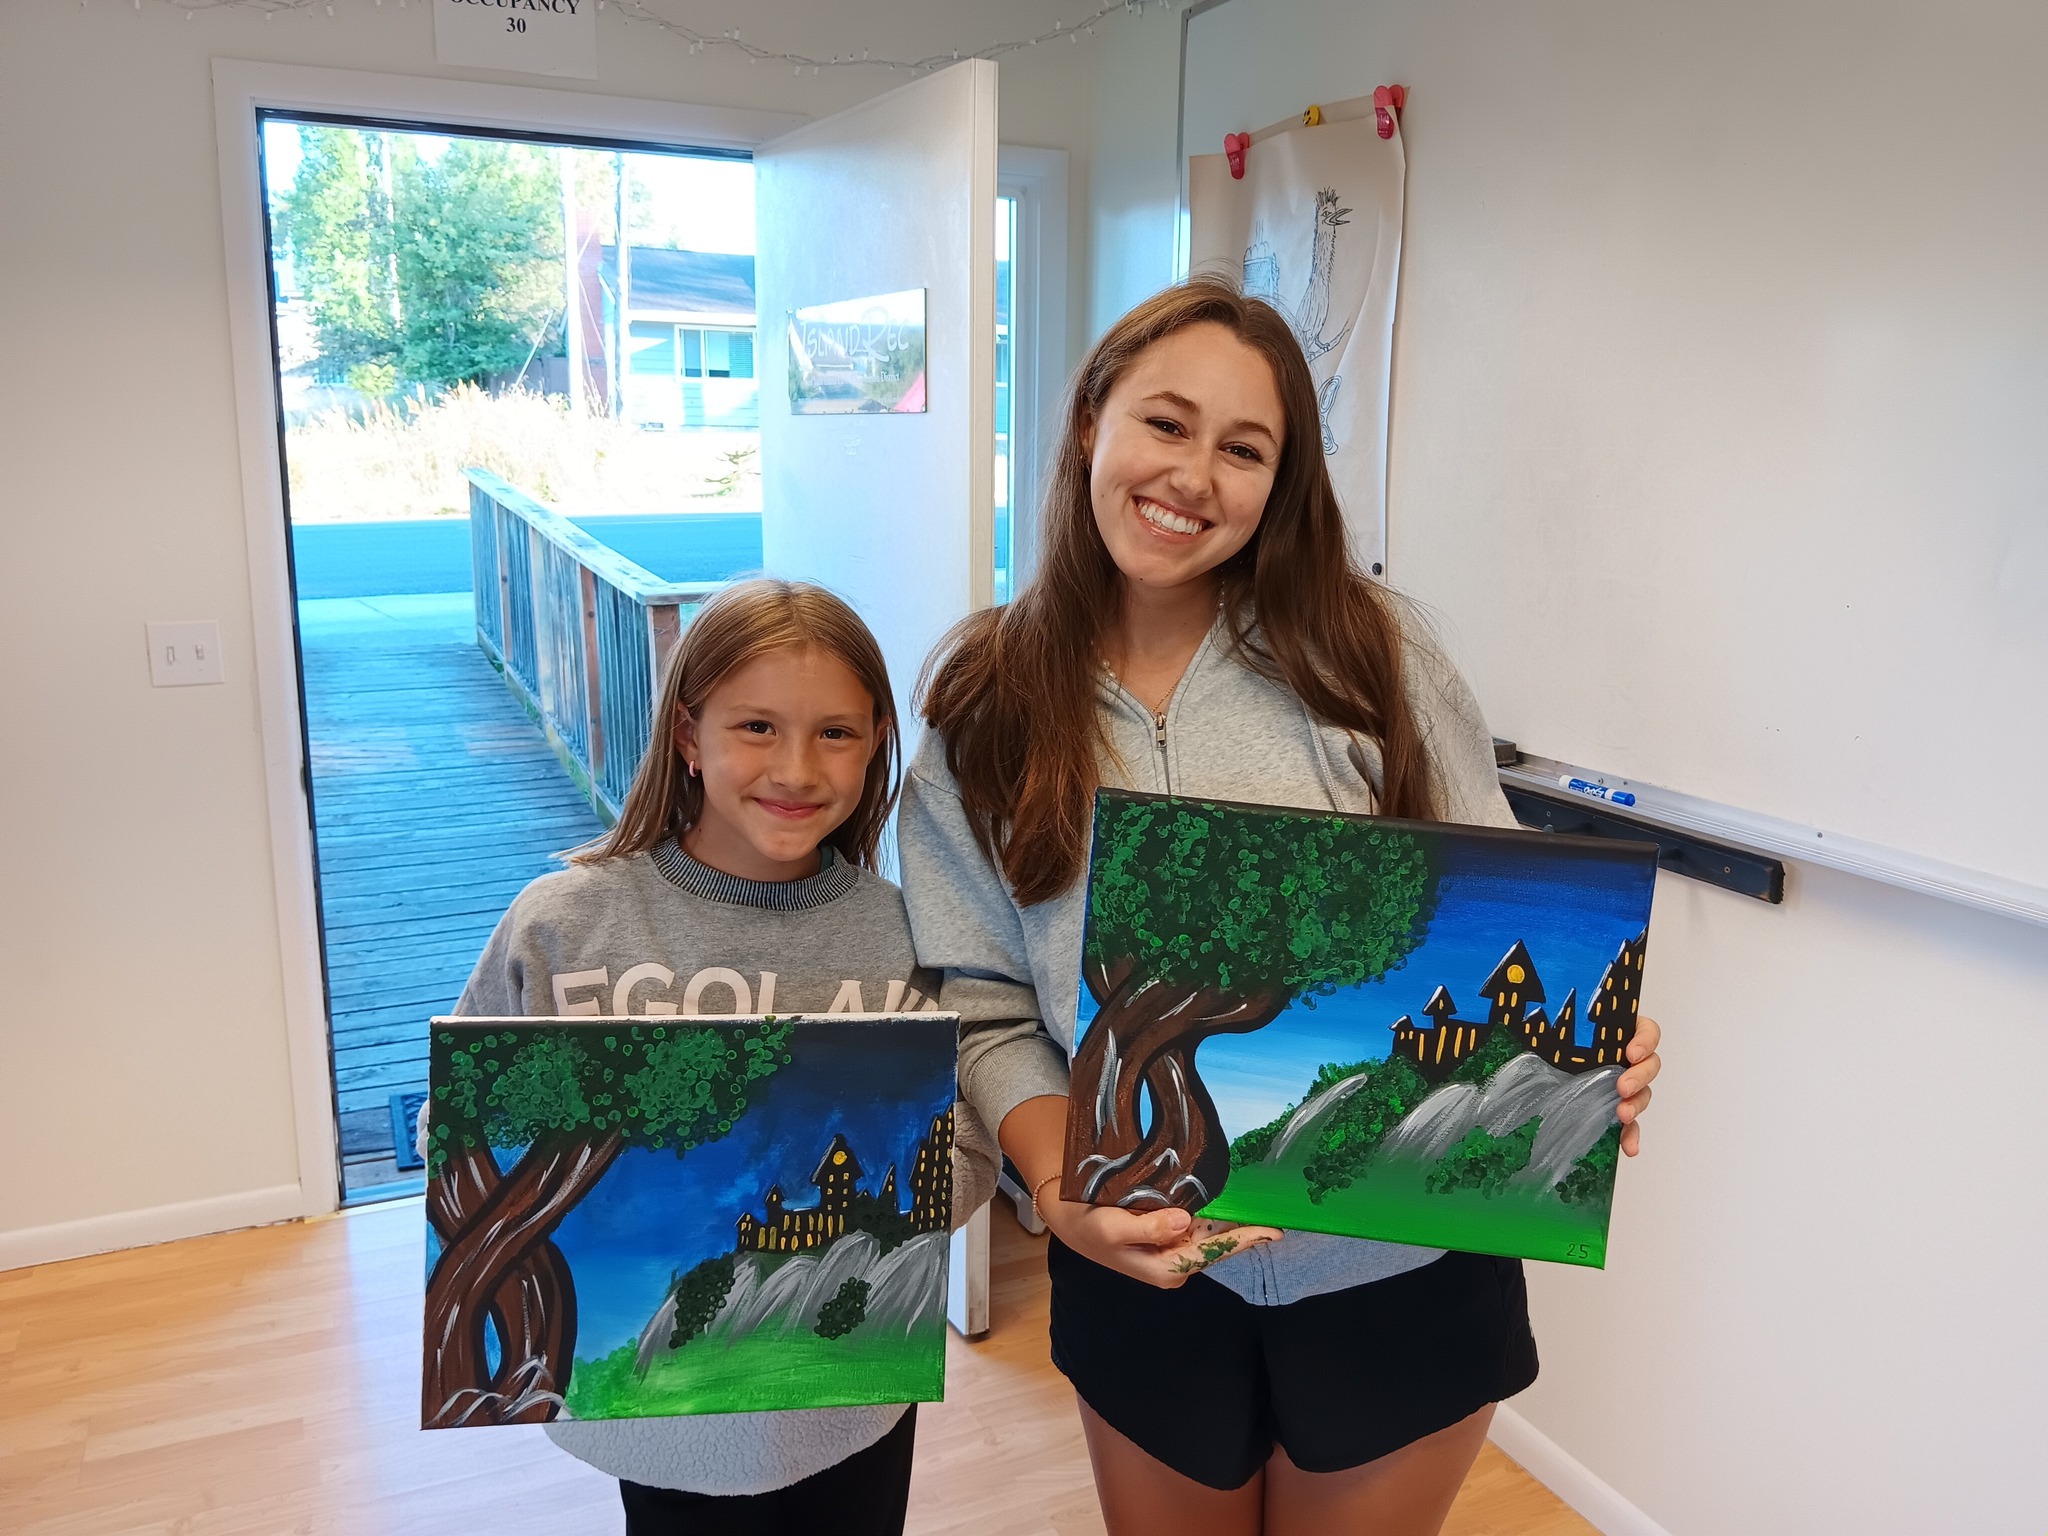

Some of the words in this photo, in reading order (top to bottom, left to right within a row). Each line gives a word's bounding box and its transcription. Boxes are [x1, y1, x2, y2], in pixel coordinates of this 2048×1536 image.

[452, 0, 580, 14] UPANCY
[506, 17, 527, 33] 30
[1566, 1243, 1590, 1259] 25
